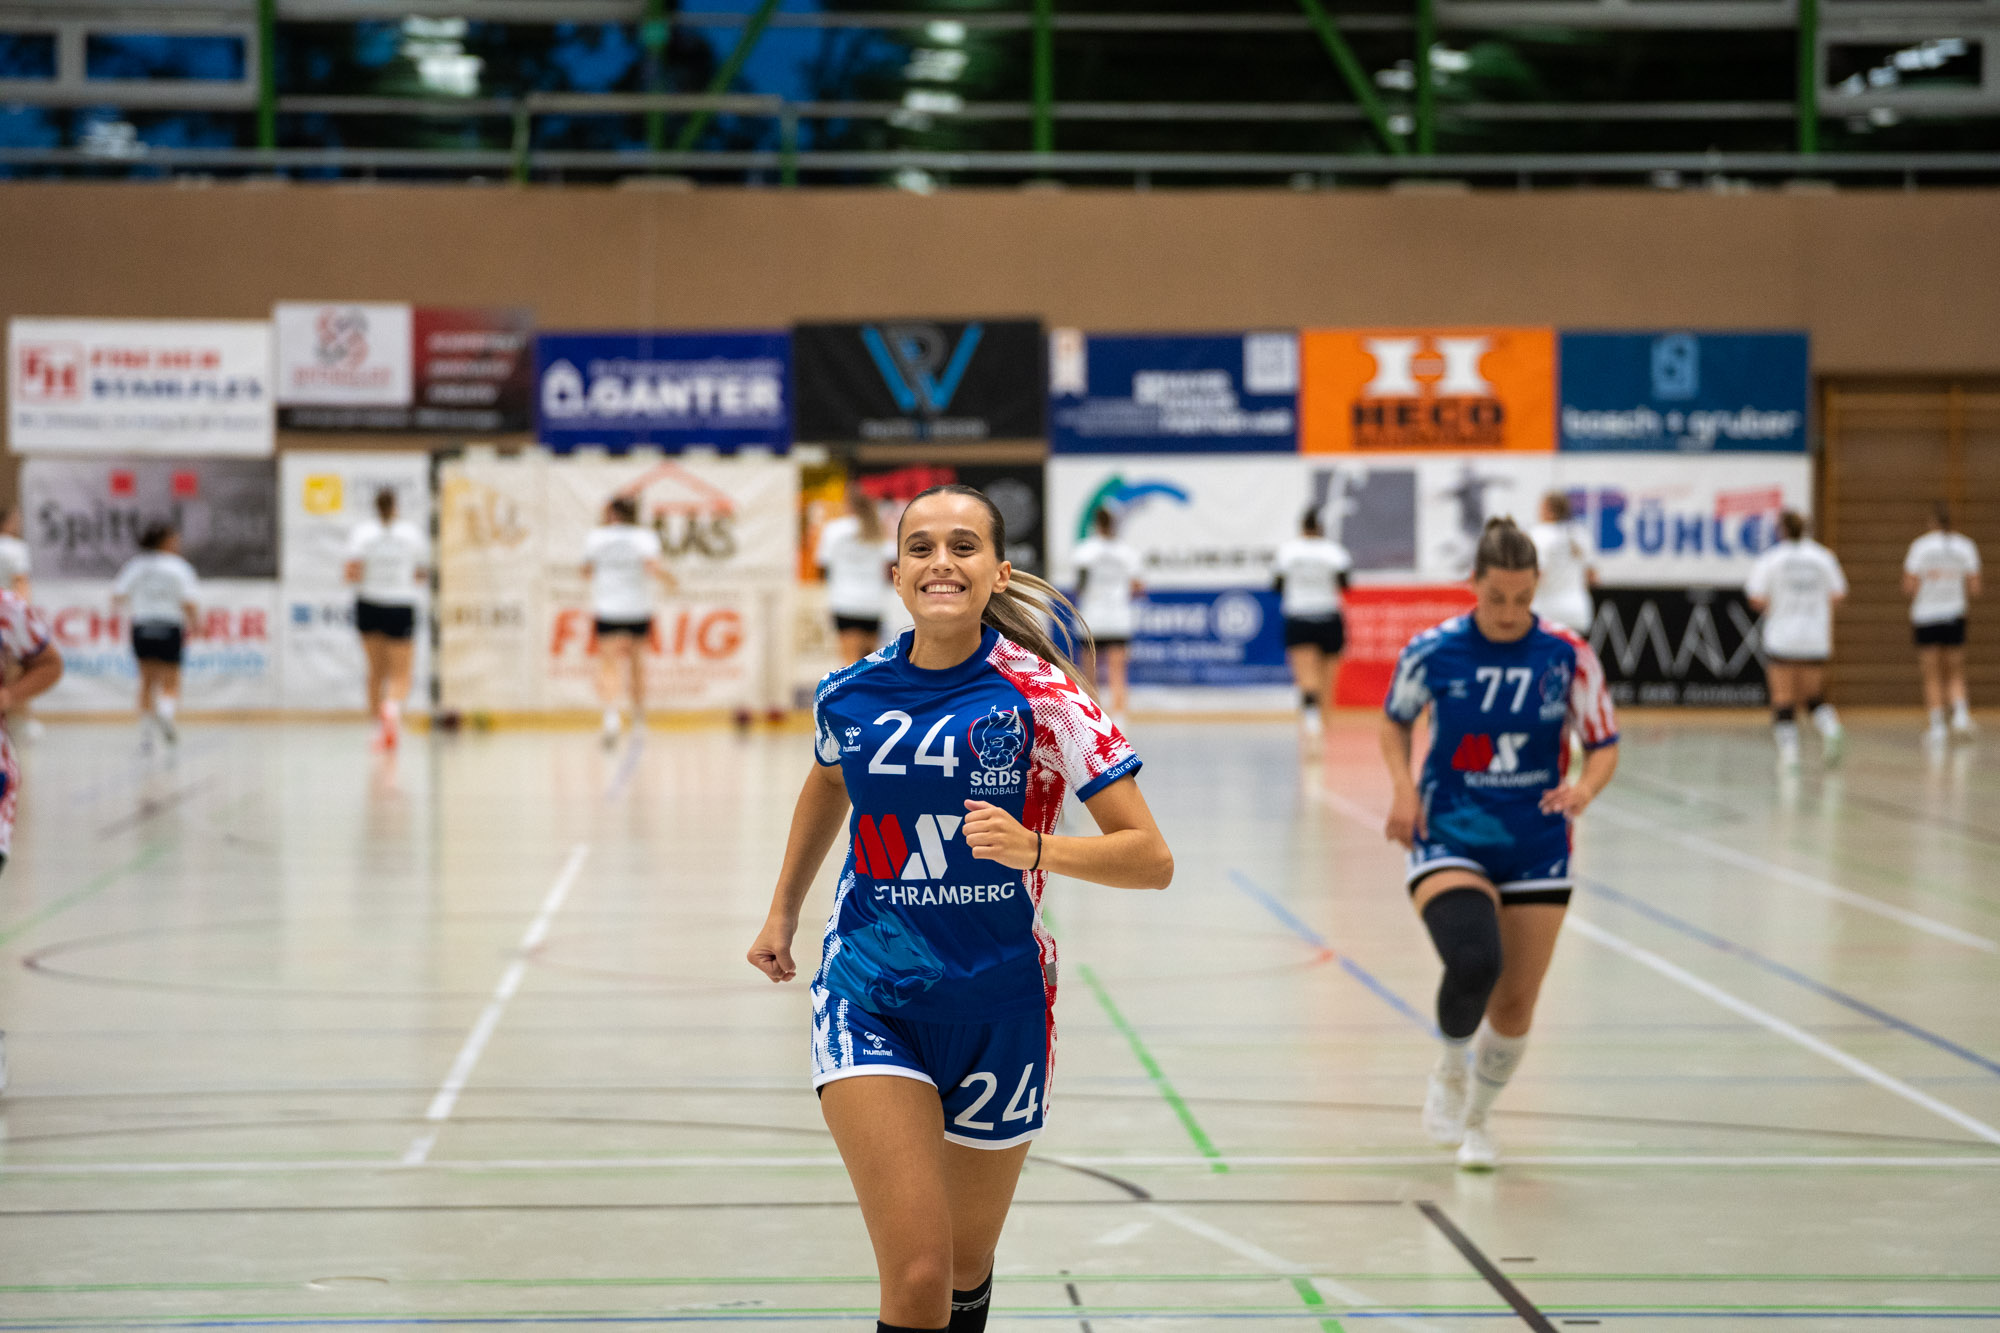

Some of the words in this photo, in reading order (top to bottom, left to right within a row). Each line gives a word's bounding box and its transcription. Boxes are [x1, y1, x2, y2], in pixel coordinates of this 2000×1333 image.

[1352, 400, 1506, 429] HECO
[1595, 488, 1787, 557] BÜHLE
[1475, 666, 1532, 713] 77
[868, 710, 959, 777] 24
[970, 770, 1021, 786] SGDS
[970, 786, 1019, 796] HANDBALL
[862, 1048, 893, 1057] hummel
[954, 1063, 1039, 1131] 24
